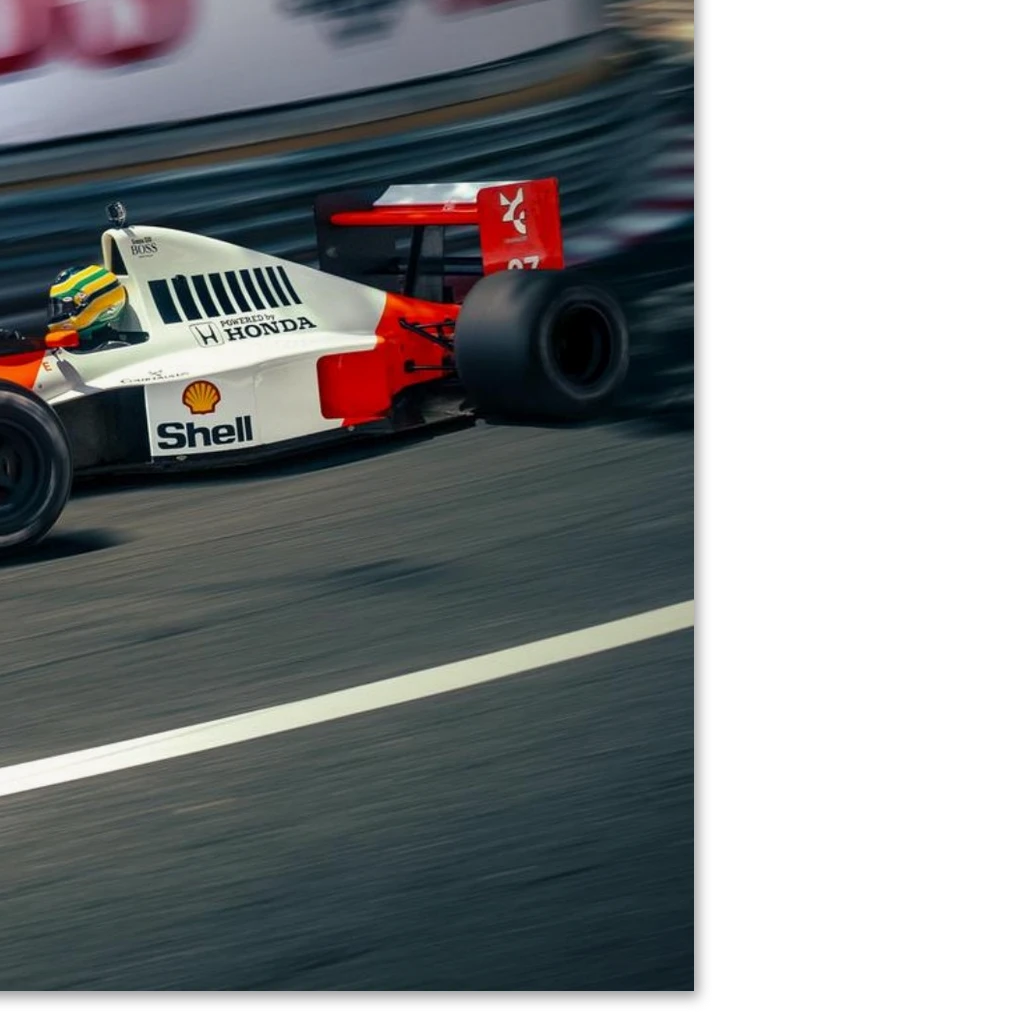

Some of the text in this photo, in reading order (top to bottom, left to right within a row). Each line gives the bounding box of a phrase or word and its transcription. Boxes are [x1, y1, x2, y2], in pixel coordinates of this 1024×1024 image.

[131, 242, 158, 256] BOSS
[220, 313, 275, 328] POWERED by
[224, 317, 317, 342] HONDA
[157, 415, 253, 450] Shell
